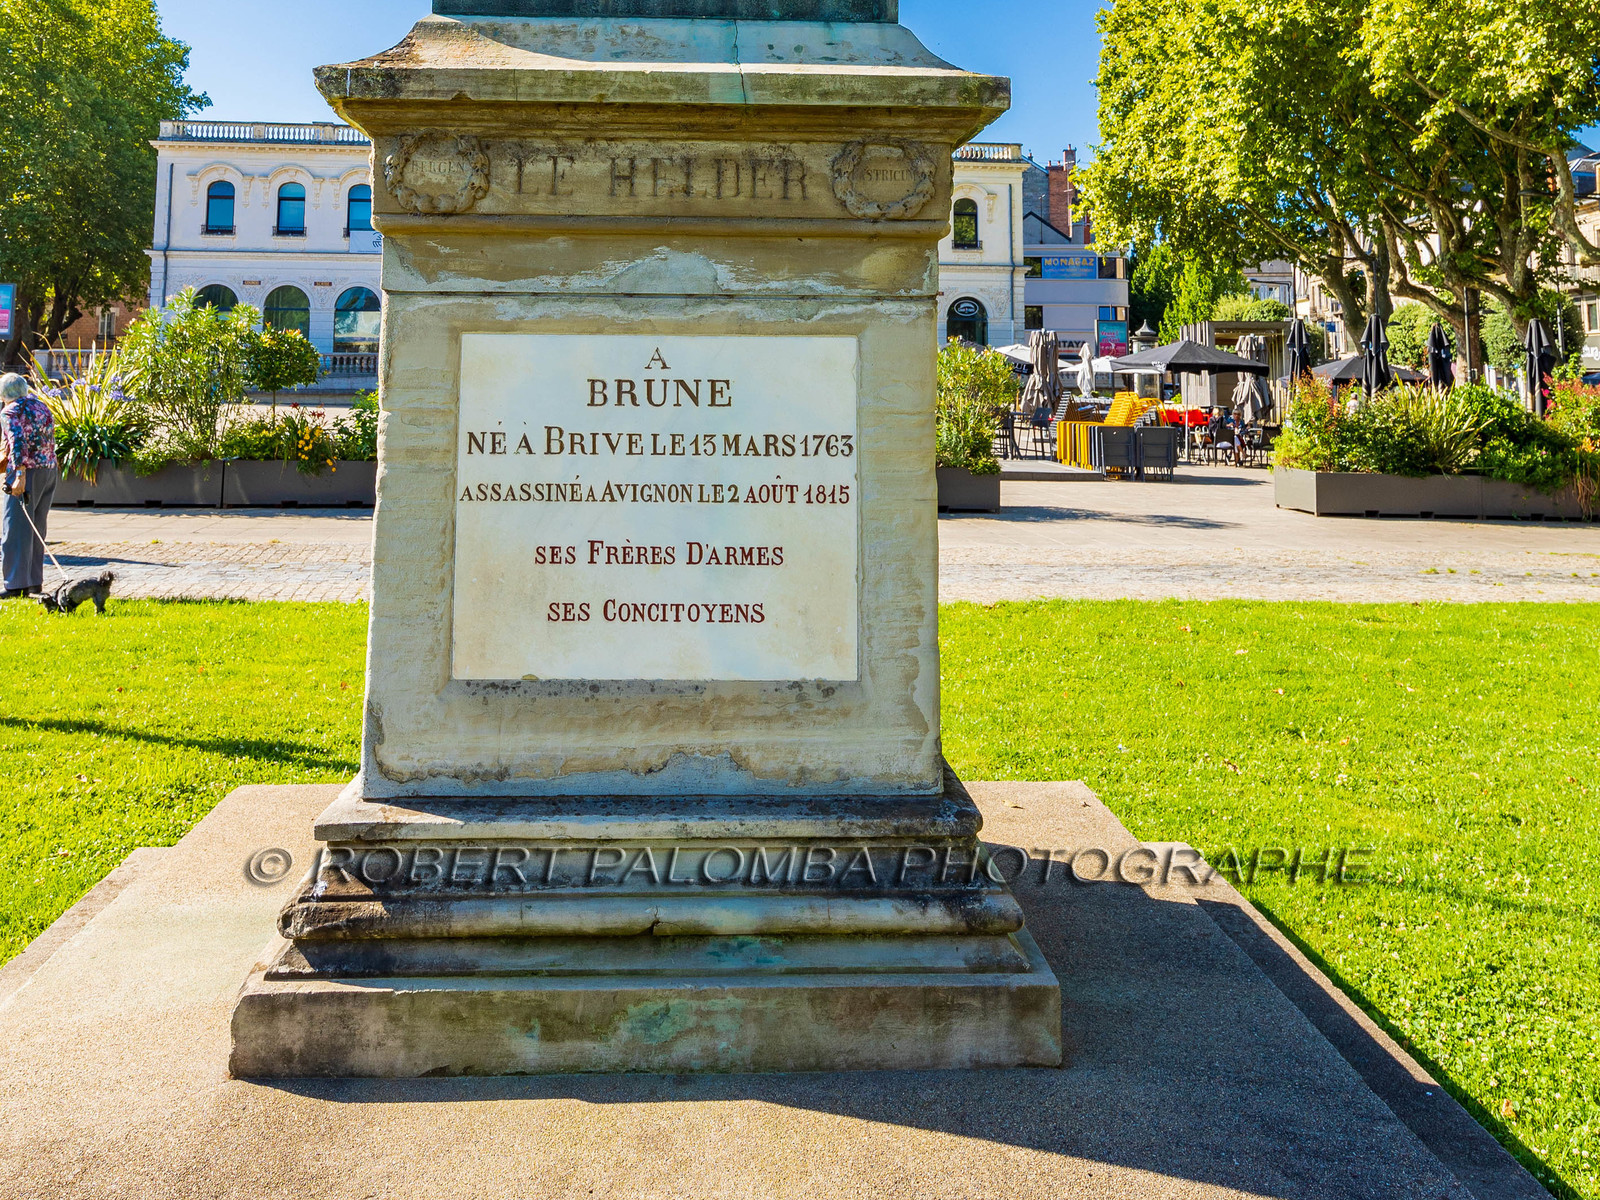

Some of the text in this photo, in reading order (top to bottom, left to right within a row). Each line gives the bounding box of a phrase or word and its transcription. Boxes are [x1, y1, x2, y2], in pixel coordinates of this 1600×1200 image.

[411, 160, 469, 177] BERGEN
[507, 153, 808, 200] LE HELDER
[1044, 257, 1095, 267] MONAGAZ
[644, 346, 671, 370] A
[1058, 340, 1087, 349] ITAYA
[586, 378, 732, 408] BRUNE
[467, 420, 854, 458] NÉ À BRIVE LE 13 MARS 1763
[459, 474, 850, 505] ASSASSINÉ A AVIGNON LE 2 AOÛT 1815
[534, 538, 784, 566] SES FRÈRES D'ARMES
[547, 598, 766, 624] SES CONCITOYENS
